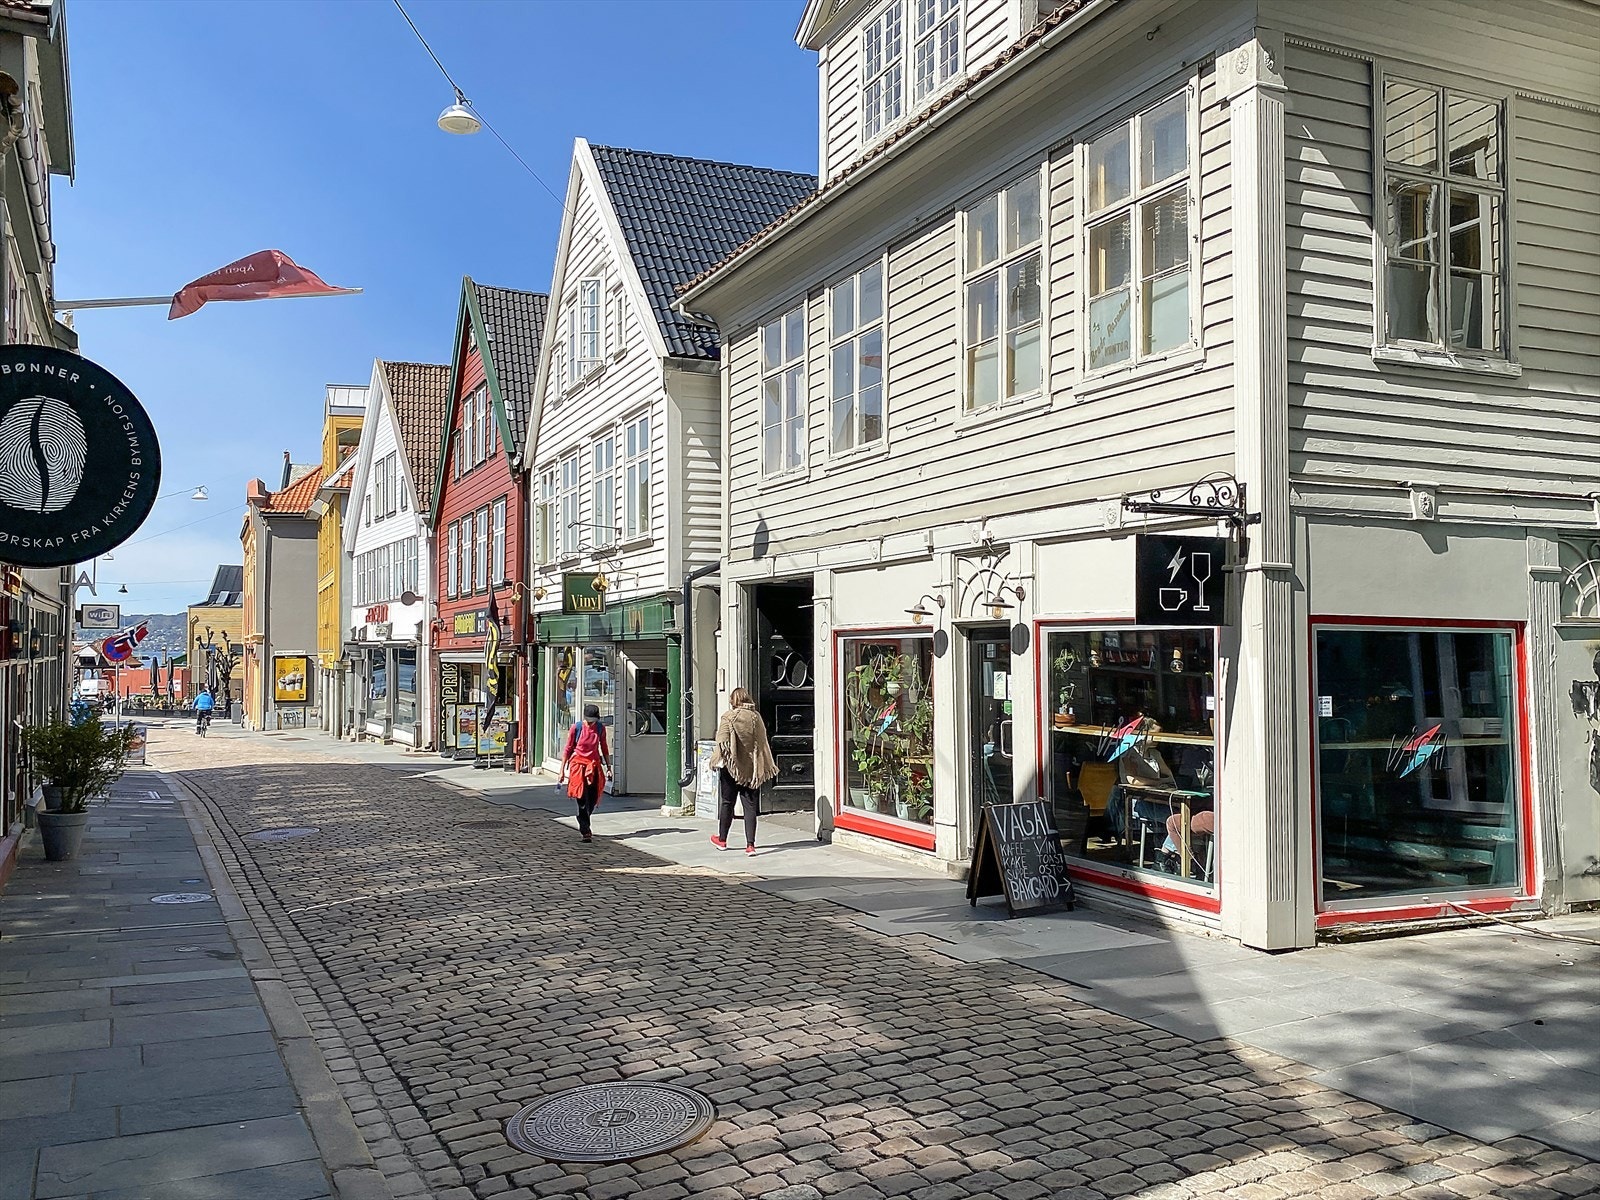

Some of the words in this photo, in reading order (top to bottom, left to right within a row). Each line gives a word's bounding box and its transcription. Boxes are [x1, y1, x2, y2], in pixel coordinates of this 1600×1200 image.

[1, 363, 80, 383] BØNNER
[103, 395, 142, 465] BYMISJON
[102, 471, 141, 526] KIRKENS
[71, 525, 102, 543] FRA
[571, 594, 601, 610] Vinyl
[1033, 836, 1057, 855] VIN
[1003, 855, 1028, 869] KAKE
[1036, 853, 1064, 864] TOAST
[1038, 864, 1057, 876] OST
